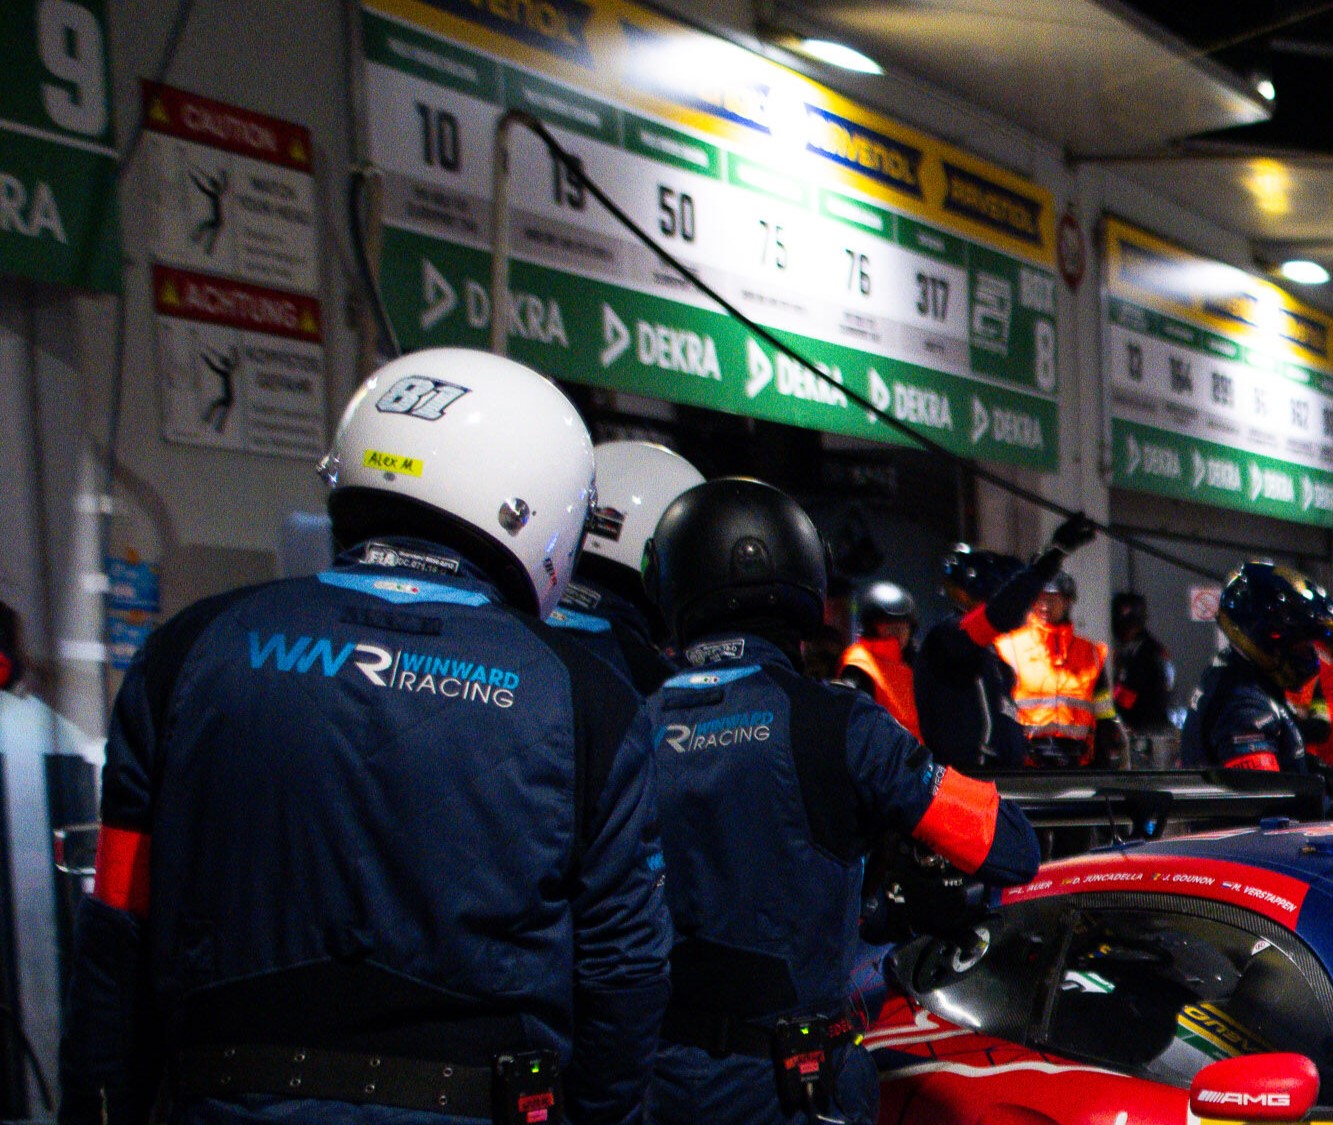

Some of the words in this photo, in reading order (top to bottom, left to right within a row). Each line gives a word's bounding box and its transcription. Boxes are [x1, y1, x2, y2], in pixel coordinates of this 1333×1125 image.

[38, 0, 108, 136] 9
[416, 101, 460, 172] 10
[657, 183, 696, 243] 50
[844, 247, 873, 297] 76
[464, 279, 570, 348] DKRA
[637, 318, 722, 381] DEKRA
[375, 374, 473, 422] 81
[894, 384, 954, 432] DEKRA
[992, 410, 1045, 452] DEKRA
[398, 671, 515, 708] RACING
[401, 652, 520, 690] WINWARD
[692, 725, 771, 752] RACING
[1026, 880, 1053, 894] AUER
[1083, 872, 1144, 884] JUNCADELLA
[1173, 873, 1217, 886] GOUNON
[1243, 884, 1298, 913] VERSTAPPEN
[1221, 1093, 1291, 1107] AMG
